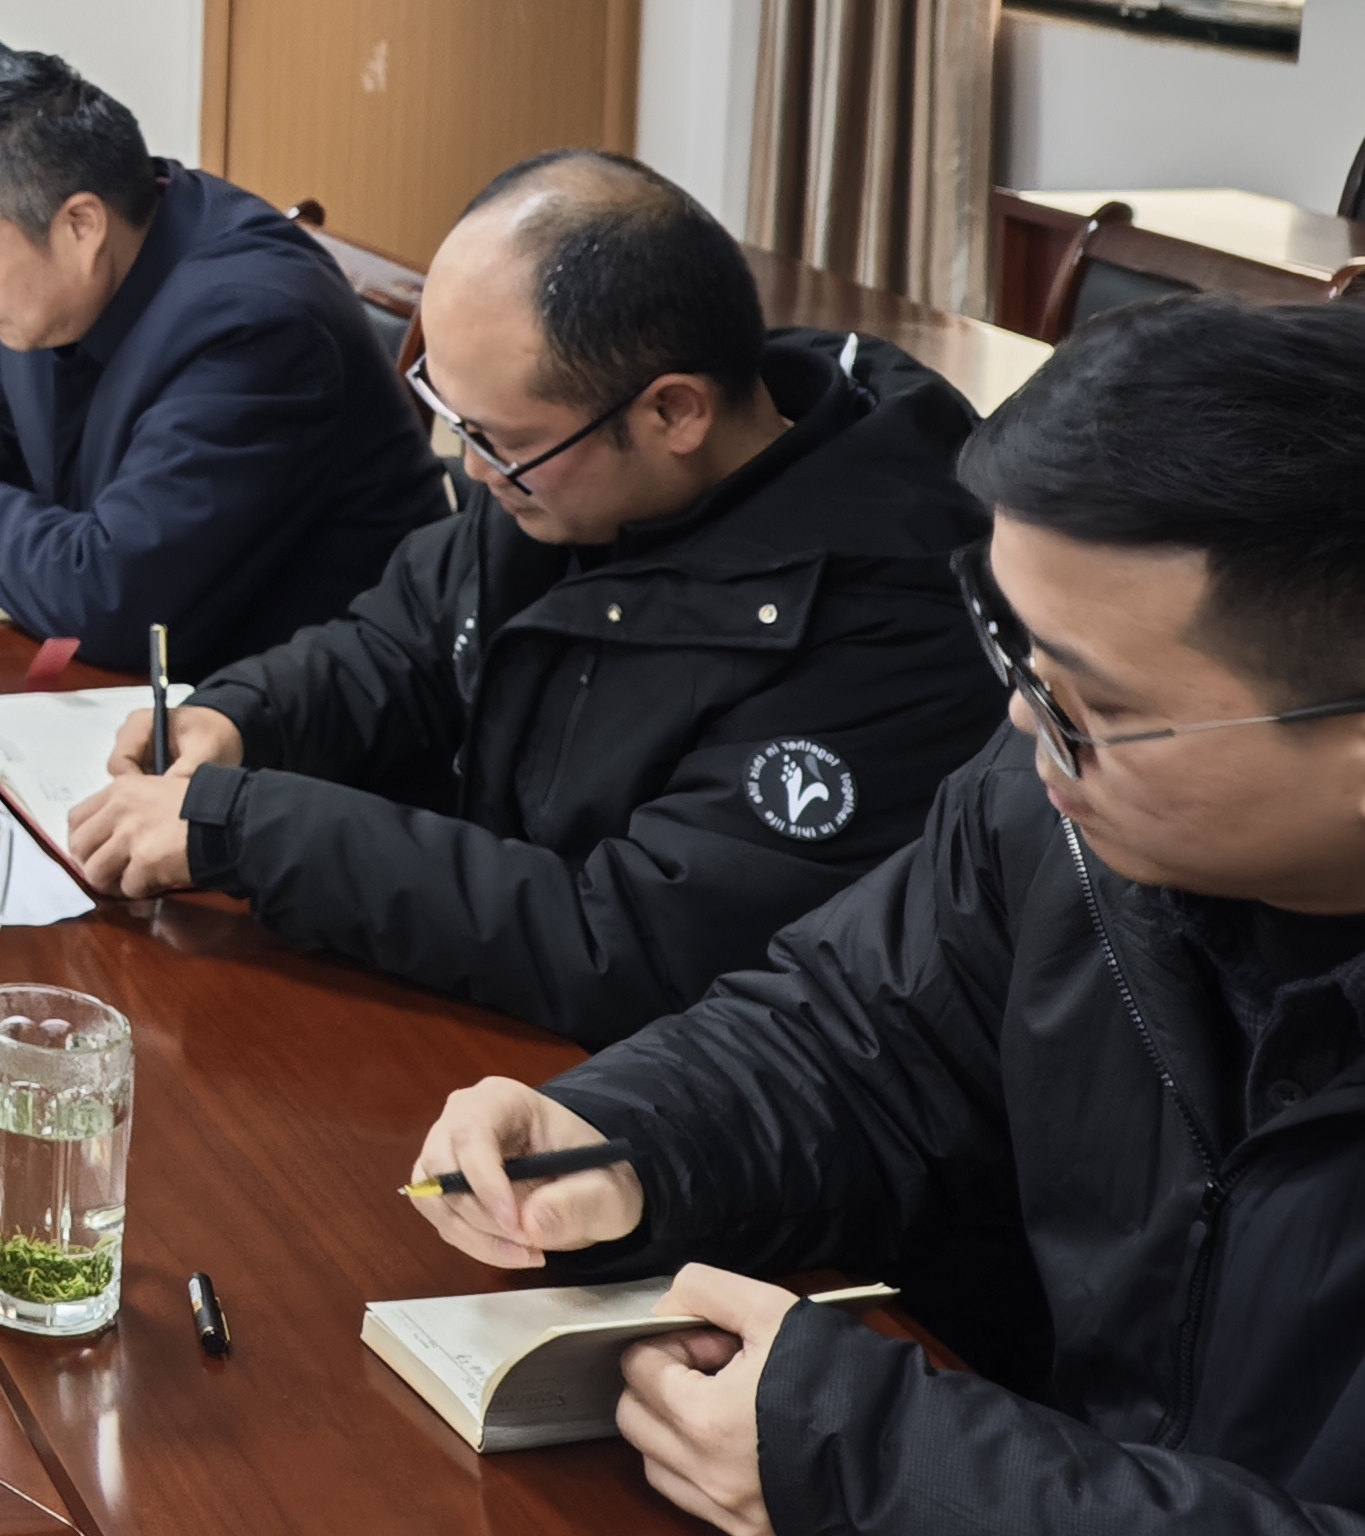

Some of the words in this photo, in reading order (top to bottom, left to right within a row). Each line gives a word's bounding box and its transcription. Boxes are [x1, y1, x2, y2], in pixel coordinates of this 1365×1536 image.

[834, 772, 855, 825] together
[764, 810, 786, 831] life
[820, 821, 837, 833] in
[788, 824, 817, 838] this
